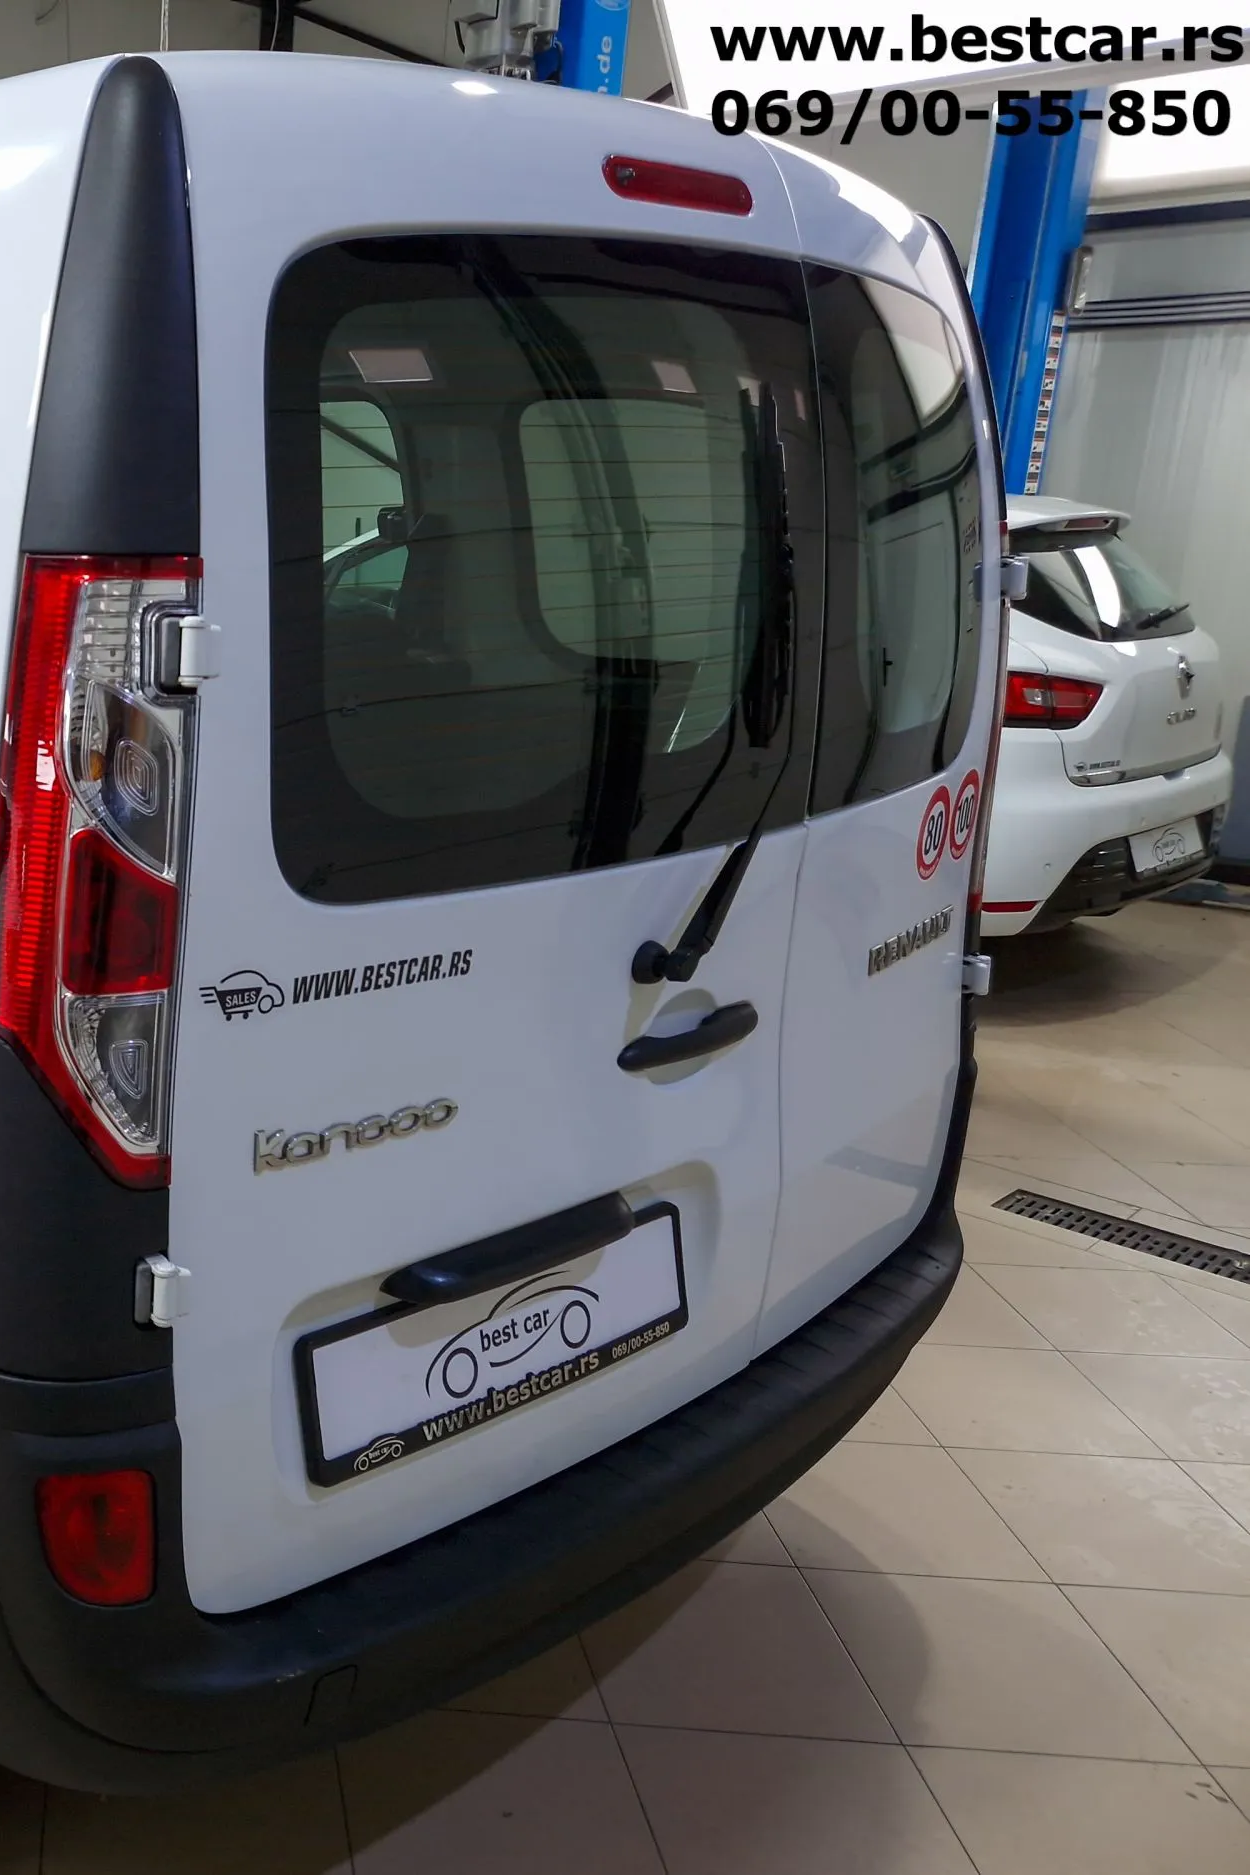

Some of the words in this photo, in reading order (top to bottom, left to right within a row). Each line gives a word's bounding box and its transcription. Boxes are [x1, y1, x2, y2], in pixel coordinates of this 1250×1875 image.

[924, 810, 944, 856] 80
[956, 796, 975, 836] 100
[868, 904, 955, 976] RENAULT
[225, 990, 258, 1008] SALES
[292, 949, 473, 1005] WWW.BESTCAR.RS
[480, 1321, 518, 1352] best
[524, 1308, 550, 1335] car
[422, 1351, 600, 1441] www.bestcar.rs
[611, 1321, 670, 1359] 069/00-55-850
